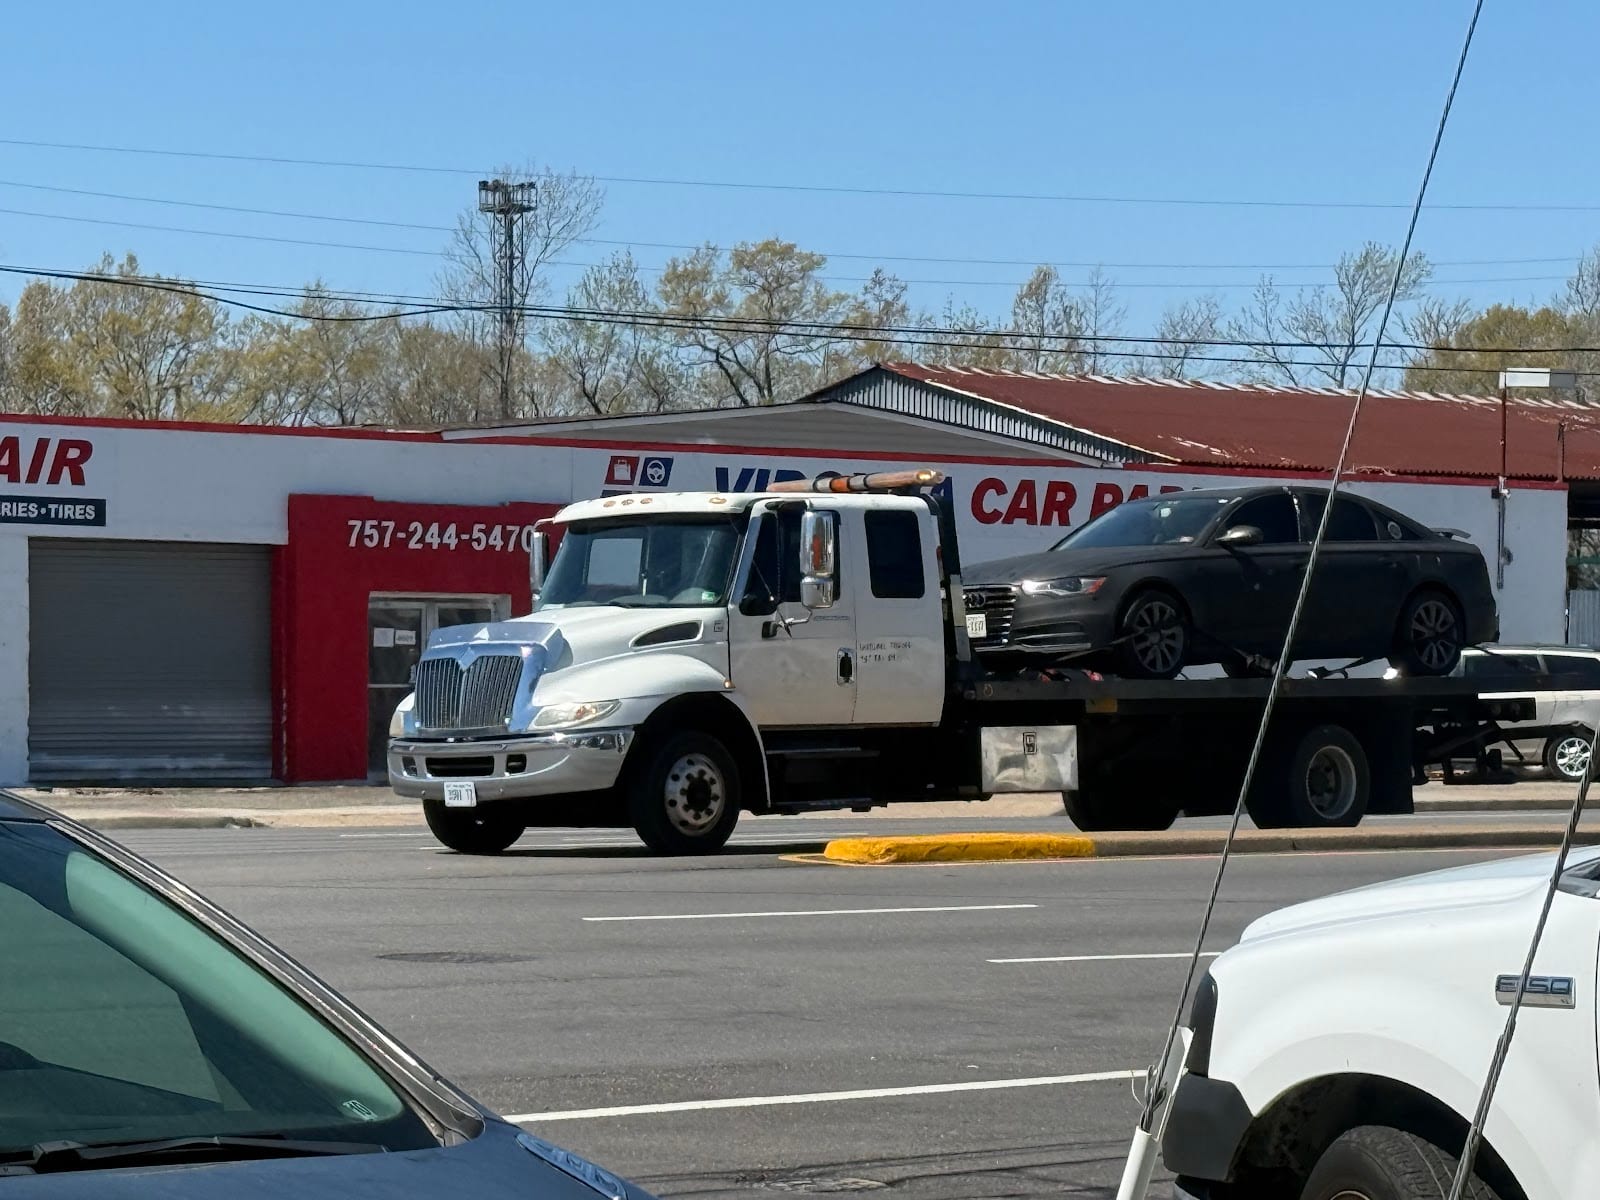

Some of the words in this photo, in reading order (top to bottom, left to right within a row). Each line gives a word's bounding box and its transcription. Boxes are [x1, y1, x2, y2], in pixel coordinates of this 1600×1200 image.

[0, 436, 93, 486] AIR
[0, 501, 39, 518] RIES
[971, 477, 1078, 527] CAR
[347, 520, 536, 553] 757-244-5470
[1498, 975, 1571, 995] F50
